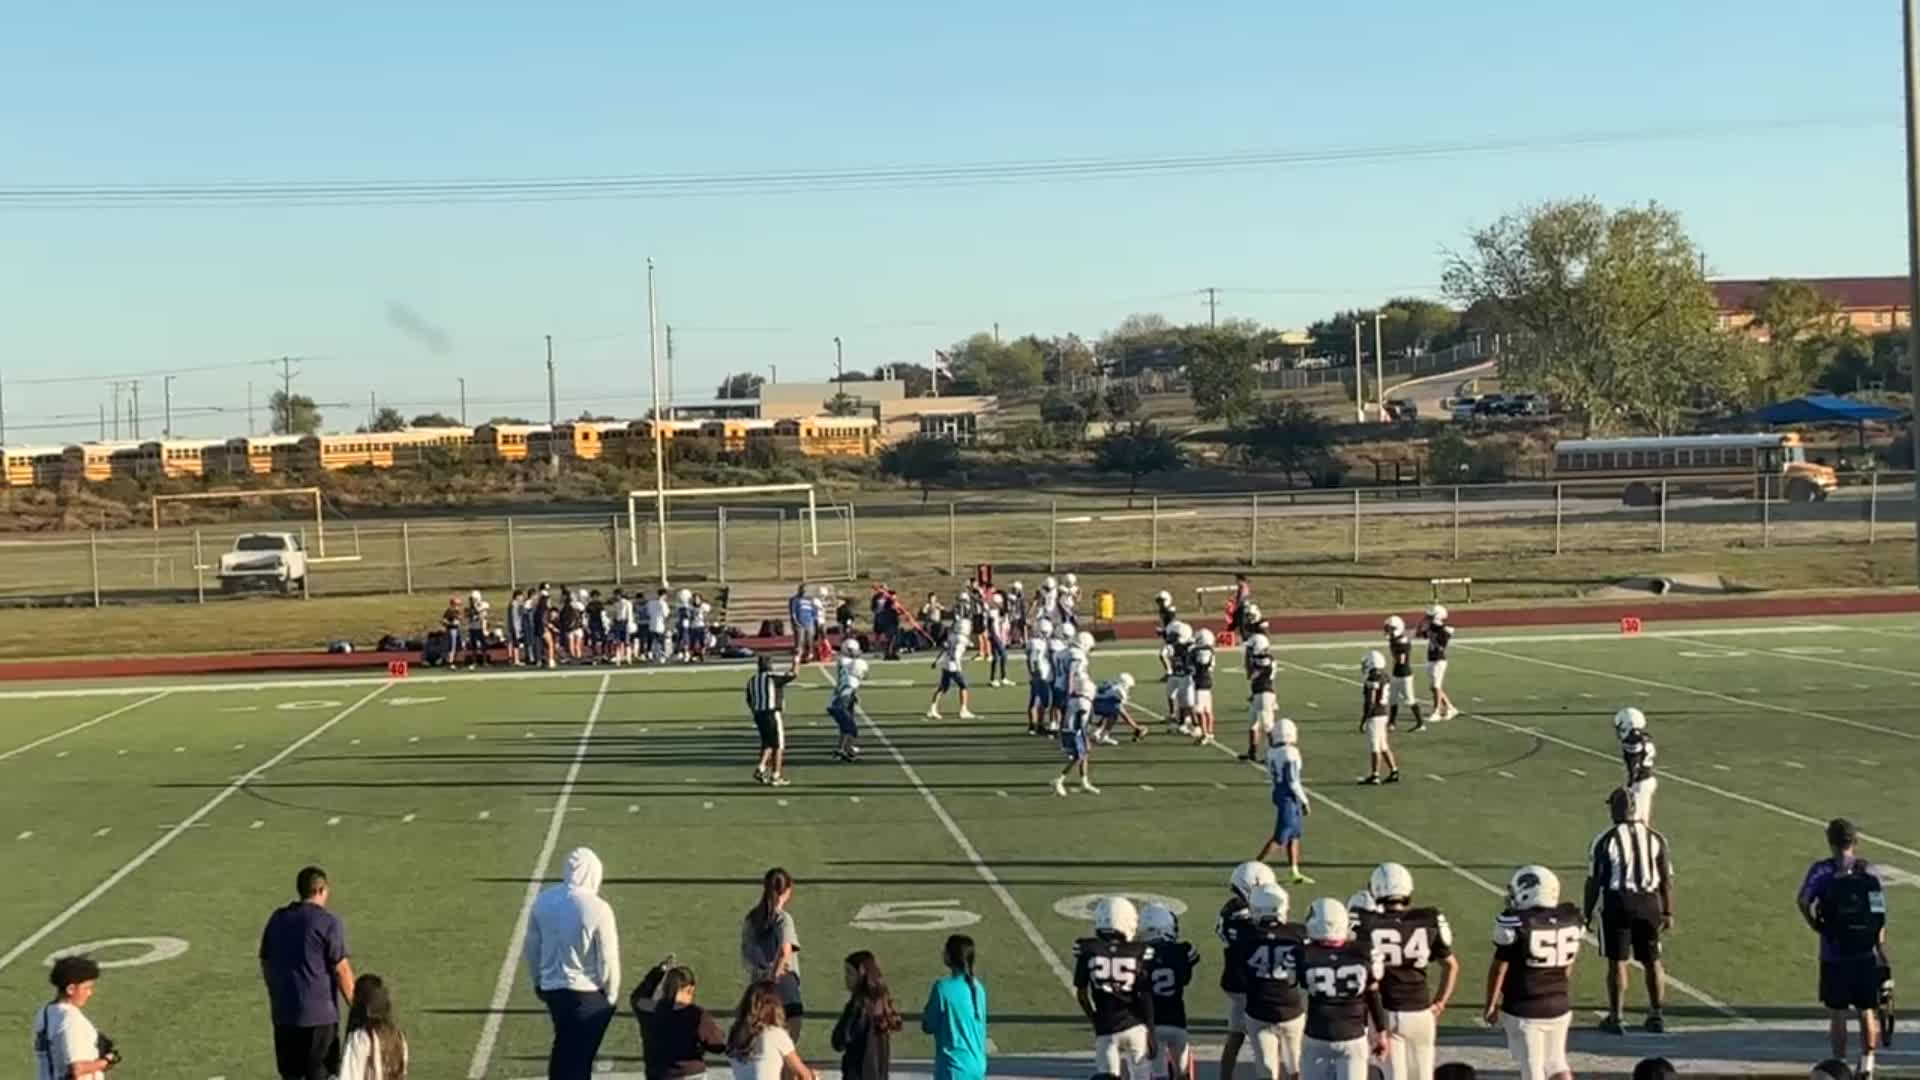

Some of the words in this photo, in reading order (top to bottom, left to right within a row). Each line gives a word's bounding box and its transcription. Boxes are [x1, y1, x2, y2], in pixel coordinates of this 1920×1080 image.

[1371, 928, 1431, 968] 64
[1526, 925, 1581, 968] 56
[1088, 956, 1137, 992] 25
[1305, 964, 1368, 997] 83
